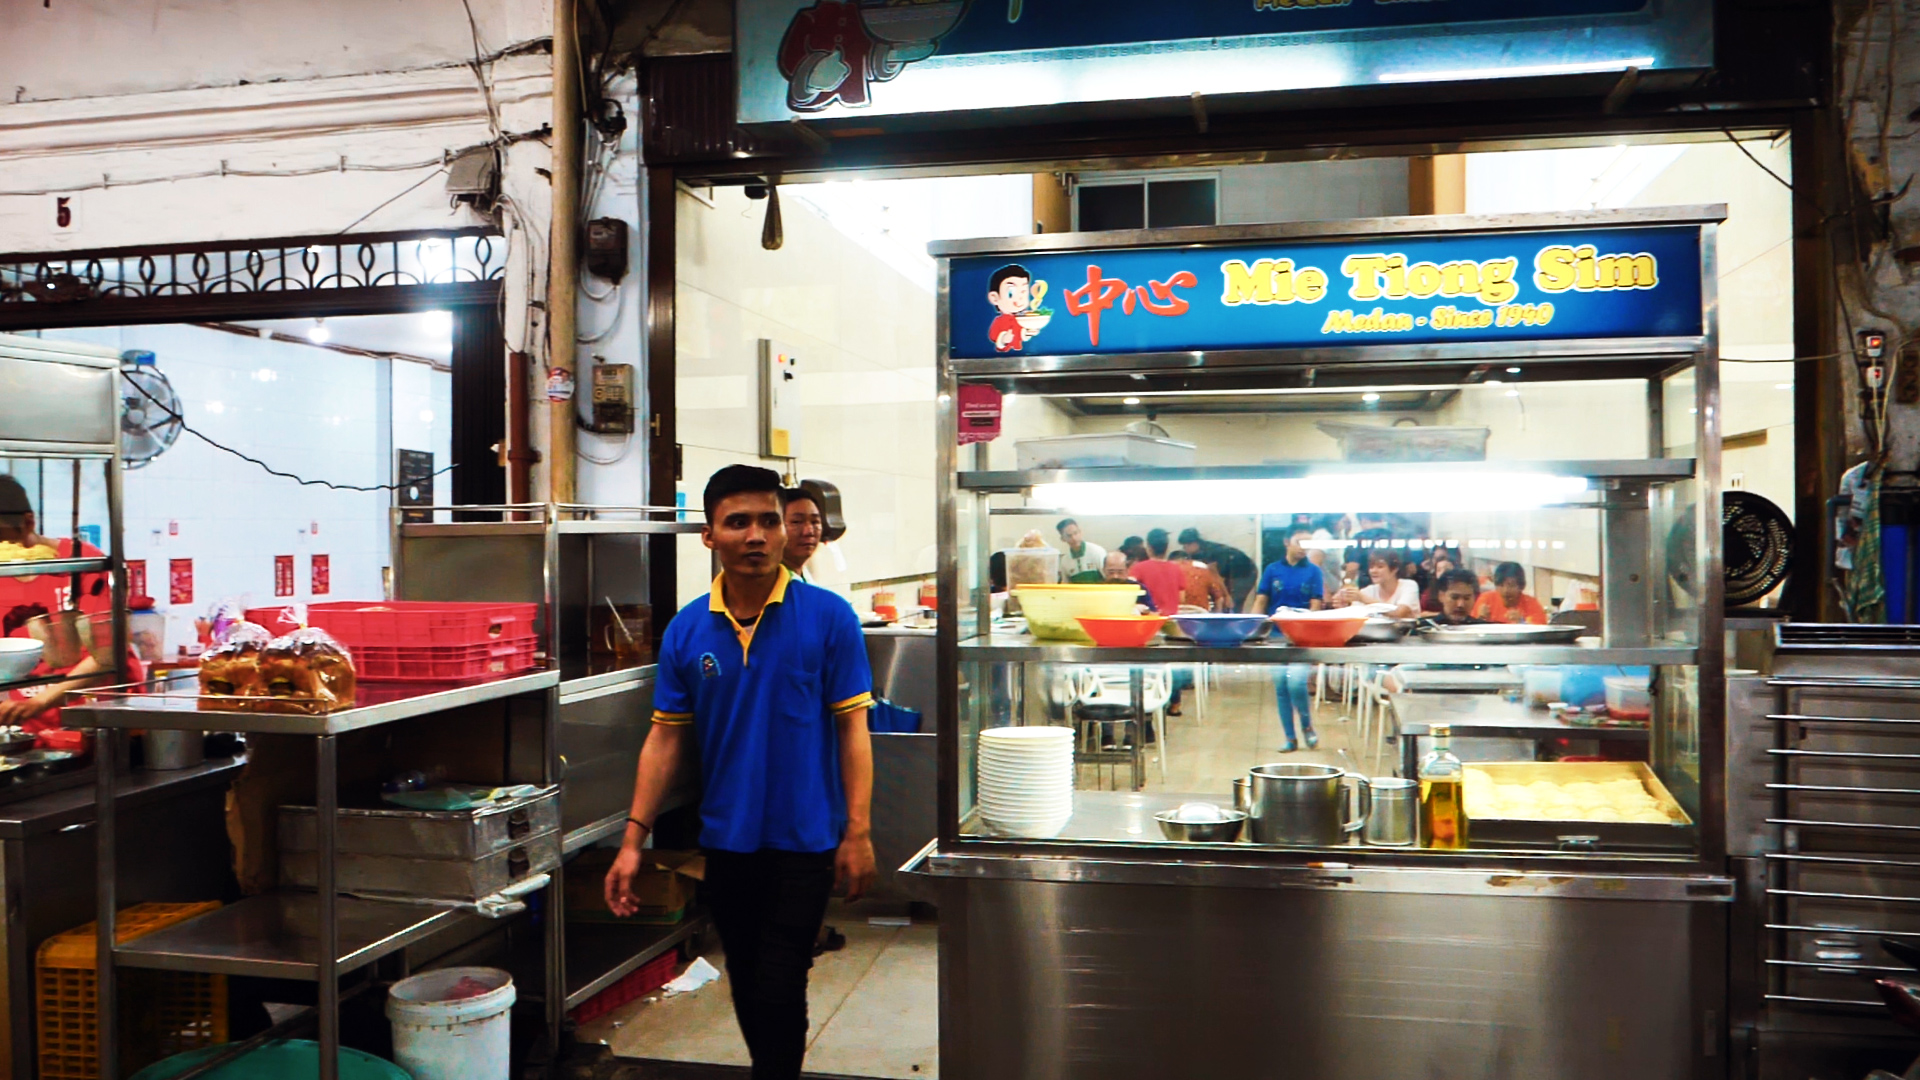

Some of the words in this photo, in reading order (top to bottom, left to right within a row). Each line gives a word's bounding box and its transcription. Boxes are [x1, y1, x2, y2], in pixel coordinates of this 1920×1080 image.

[56, 196, 72, 228] 5
[1221, 258, 1328, 305] Mie
[1341, 252, 1519, 305] Tiong
[1533, 244, 1659, 292] Sim
[1063, 264, 1198, 347] 中心
[1321, 307, 1414, 334] Medan
[1429, 305, 1494, 330] Since
[1495, 302, 1555, 327] 1940
